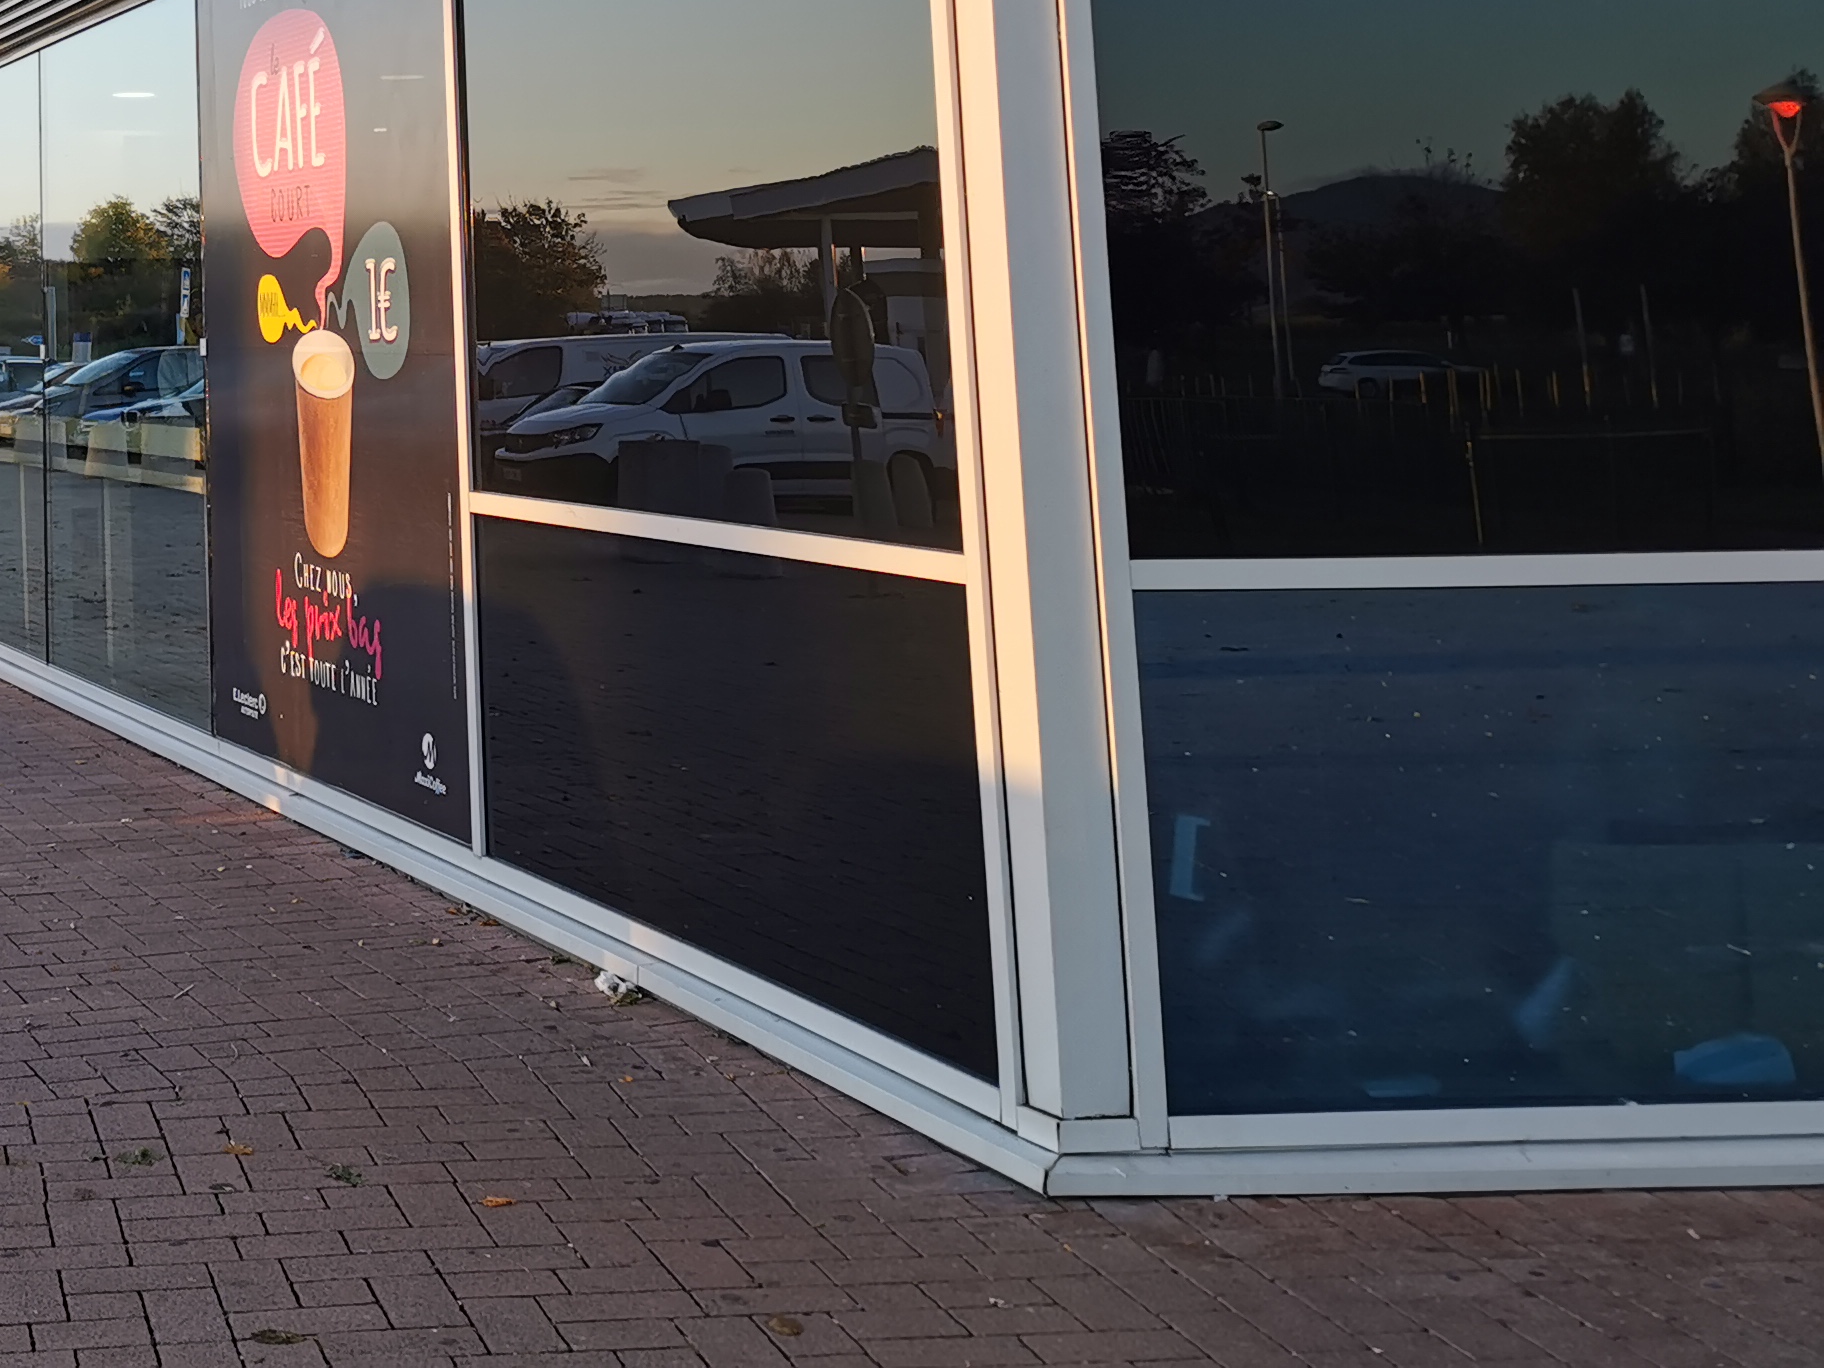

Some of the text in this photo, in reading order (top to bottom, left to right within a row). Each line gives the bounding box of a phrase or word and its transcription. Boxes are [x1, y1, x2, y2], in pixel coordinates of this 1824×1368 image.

[251, 26, 327, 178] CAFÉ
[270, 184, 311, 223] COURT
[364, 257, 399, 343] 1€
[275, 567, 383, 681] les prix bas
[280, 639, 379, 707] C'EST TOUTE L'ANNÉE
